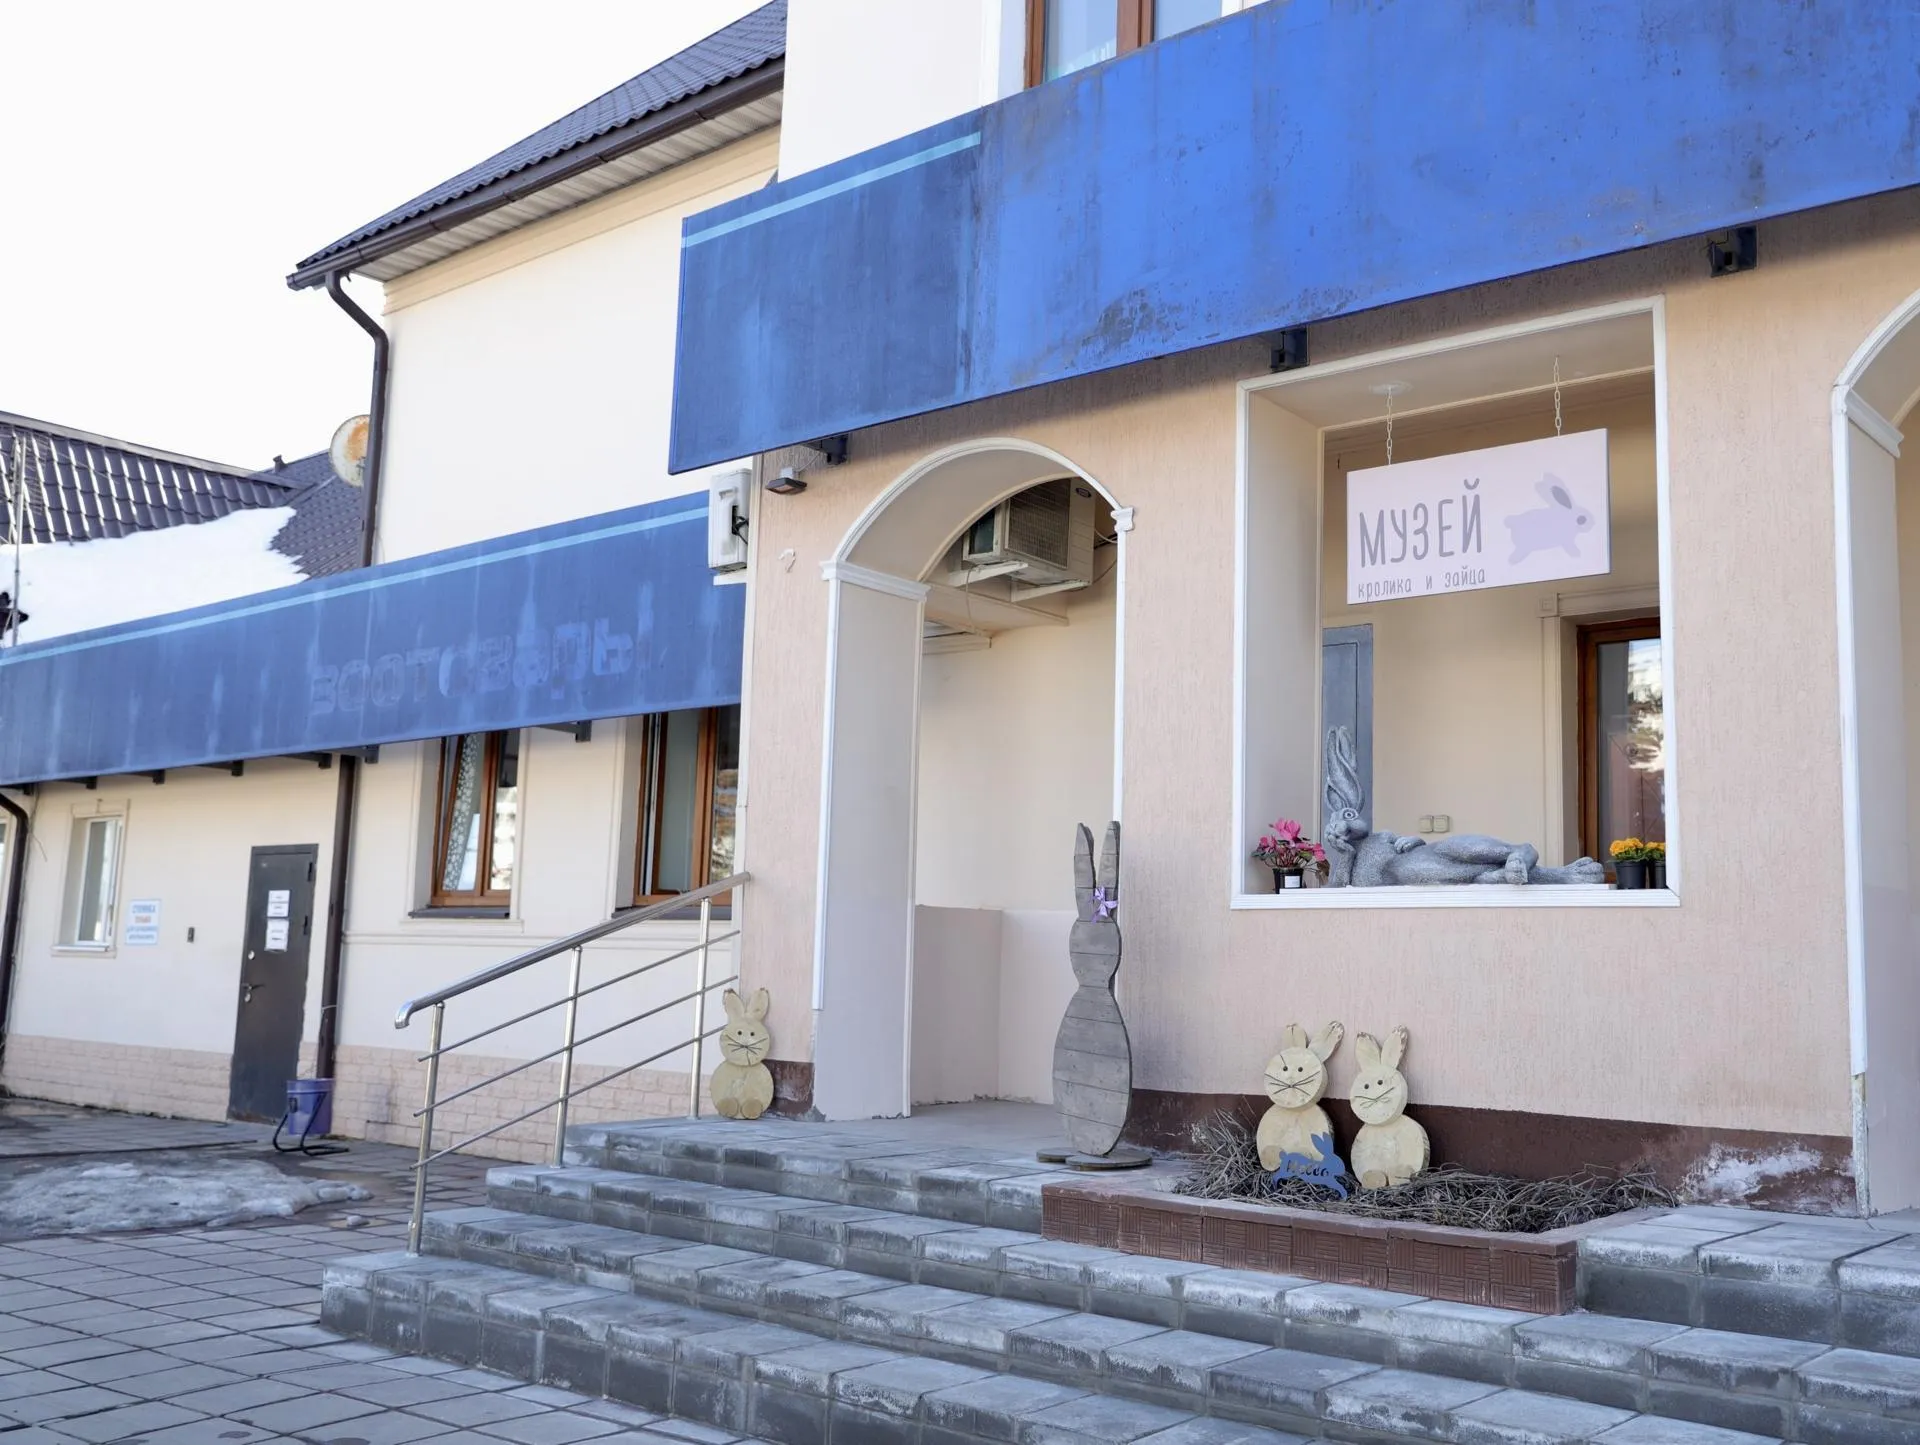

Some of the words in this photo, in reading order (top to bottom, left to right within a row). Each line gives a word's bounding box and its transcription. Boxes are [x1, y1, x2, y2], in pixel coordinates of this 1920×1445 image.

[1359, 478, 1482, 568] МУЗЕЙ
[1358, 577, 1412, 602] кролика
[1425, 575, 1433, 590] и
[1444, 565, 1486, 588] зайца
